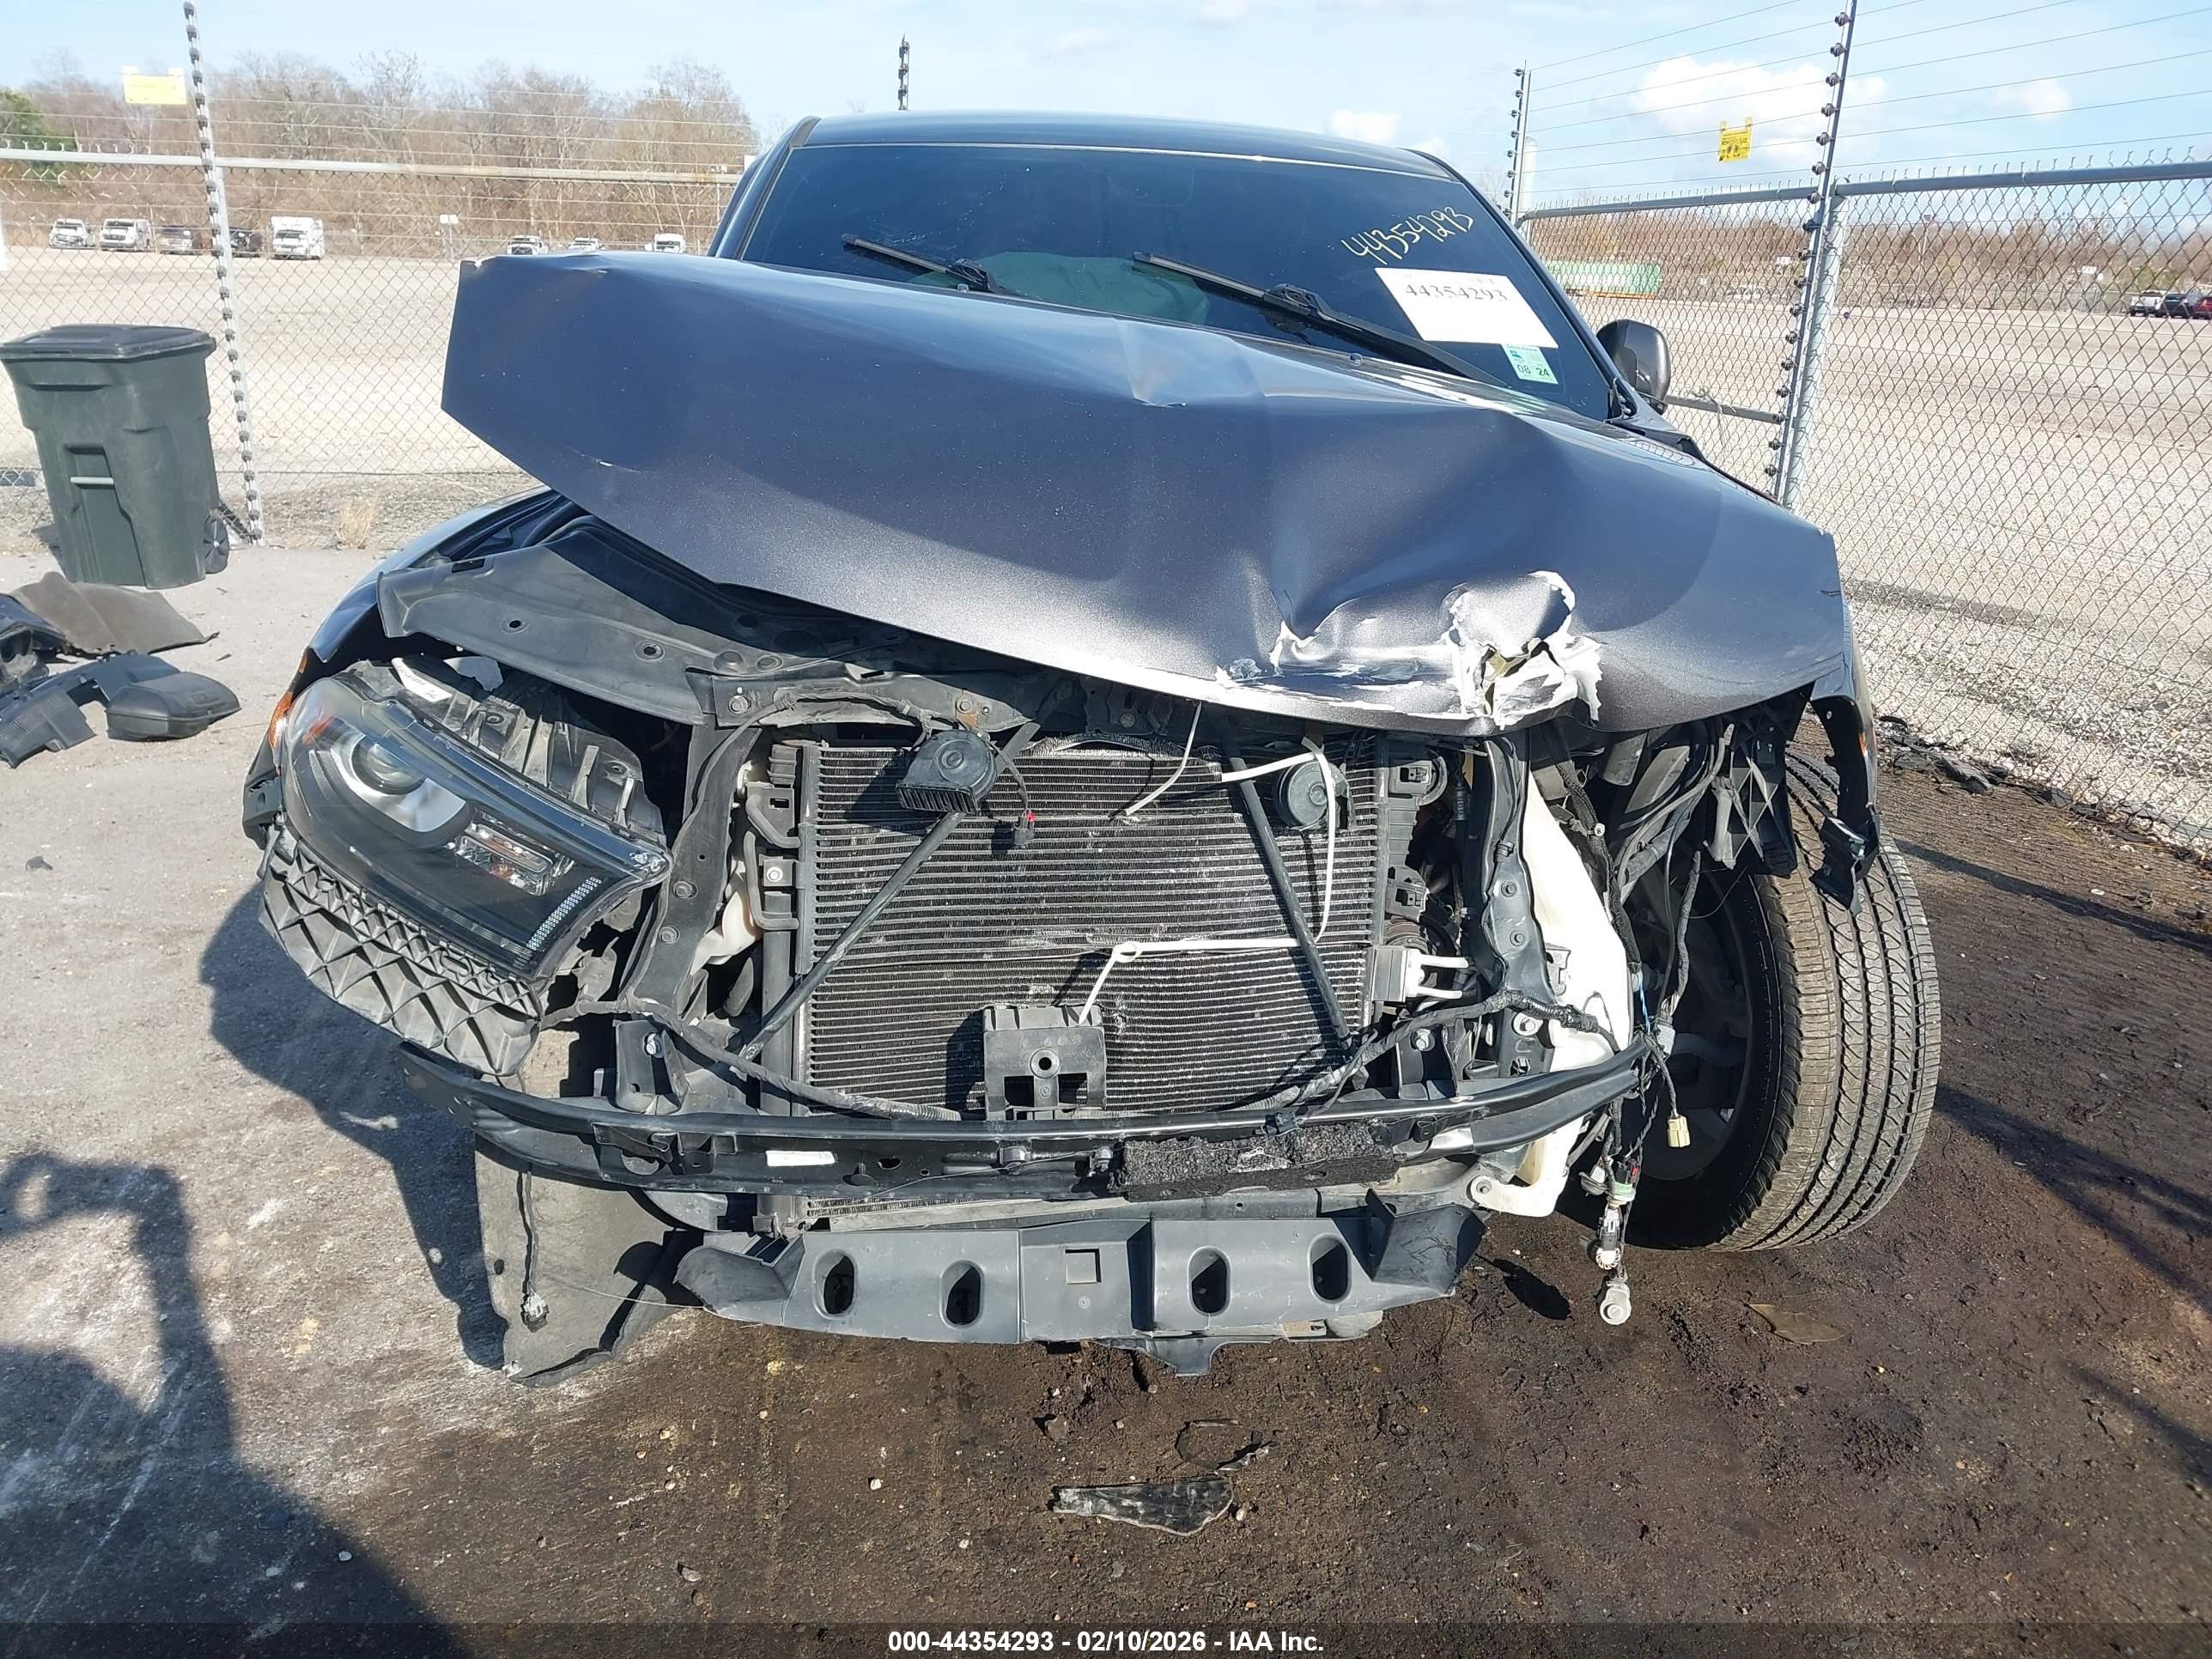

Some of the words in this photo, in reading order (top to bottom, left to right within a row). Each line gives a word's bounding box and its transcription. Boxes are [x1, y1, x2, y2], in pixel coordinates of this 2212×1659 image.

[1340, 206, 1474, 265] 44354293
[1406, 284, 1508, 302] 44354293
[1516, 363, 1532, 374] 08
